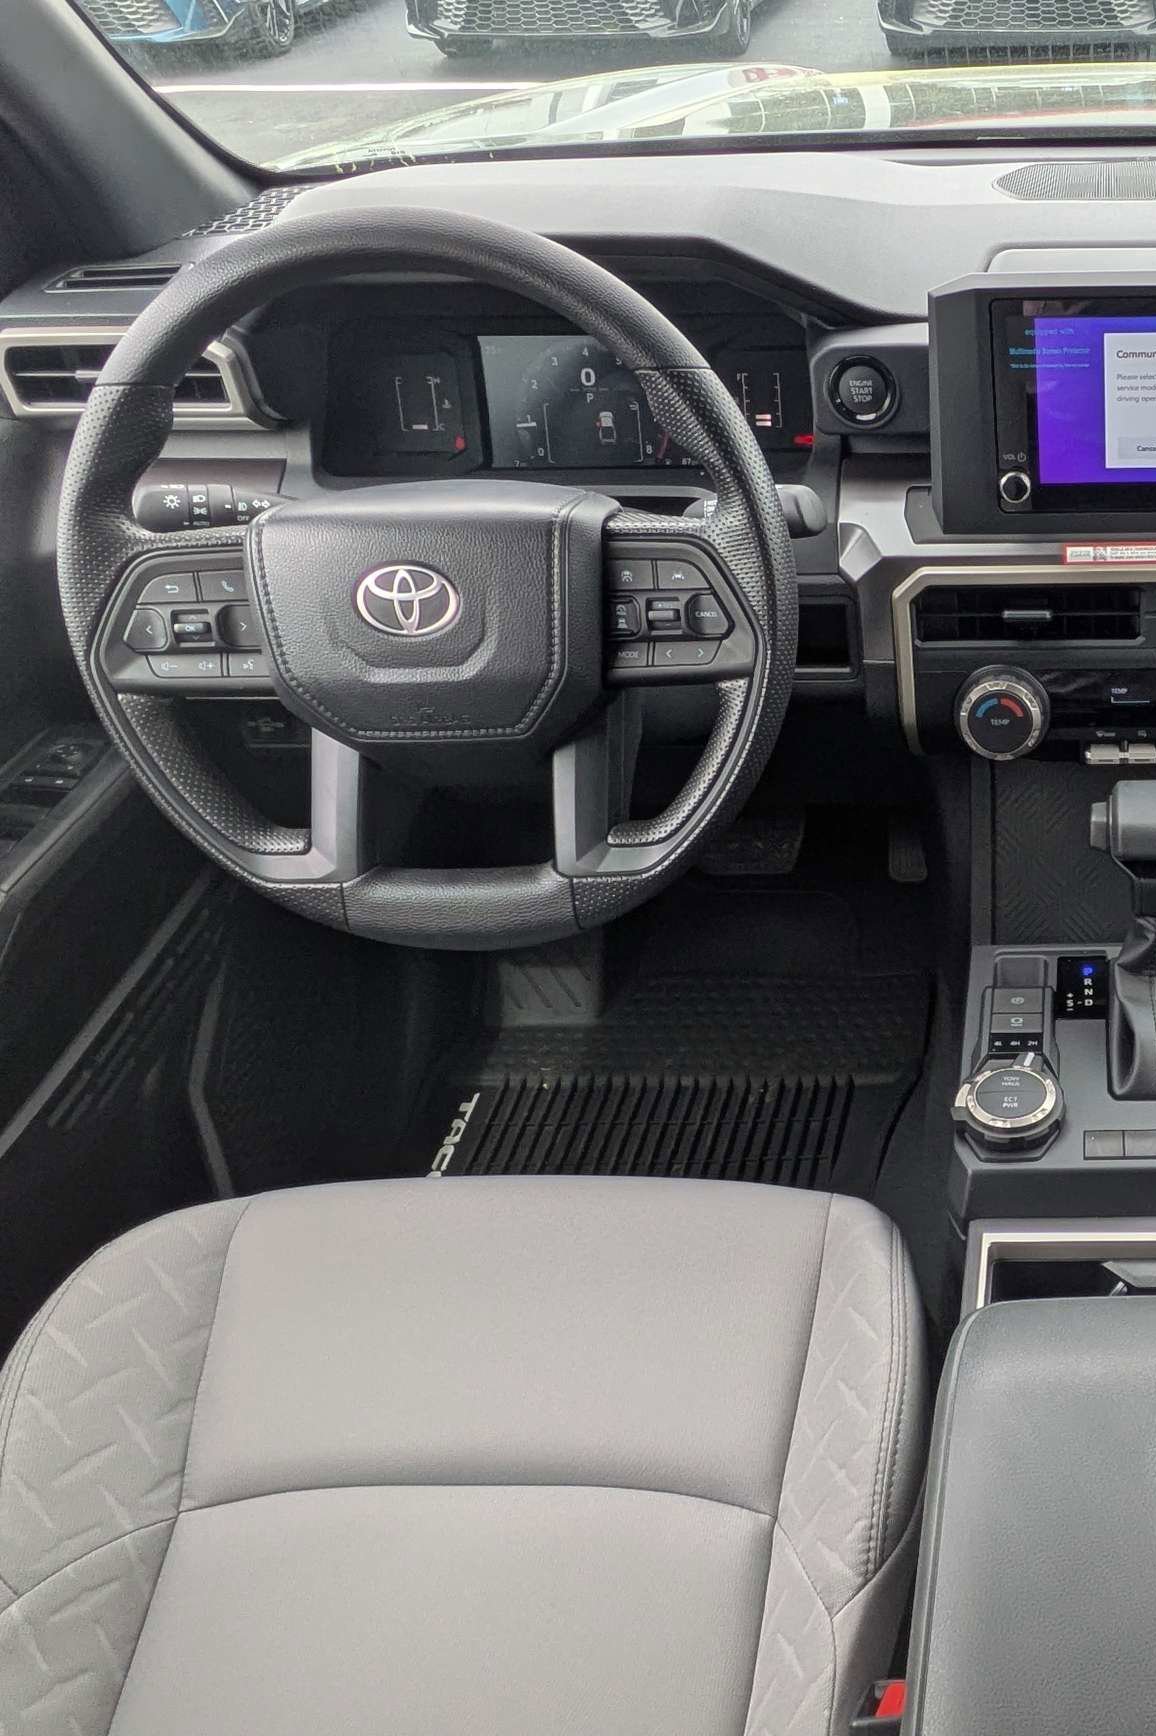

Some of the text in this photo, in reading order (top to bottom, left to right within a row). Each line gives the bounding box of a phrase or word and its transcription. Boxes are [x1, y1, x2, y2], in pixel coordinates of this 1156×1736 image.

[582, 346, 589, 356] 4
[551, 357, 559, 366] 3
[580, 367, 596, 386] 0
[531, 380, 538, 390] 2
[850, 387, 873, 395] START
[586, 393, 594, 403] P
[1116, 395, 1140, 403] driving
[618, 650, 640, 658] MODE
[1083, 967, 1093, 976] P
[1083, 978, 1092, 986] R
[1066, 999, 1074, 1007] S
[425, 1093, 480, 1177] TAC
